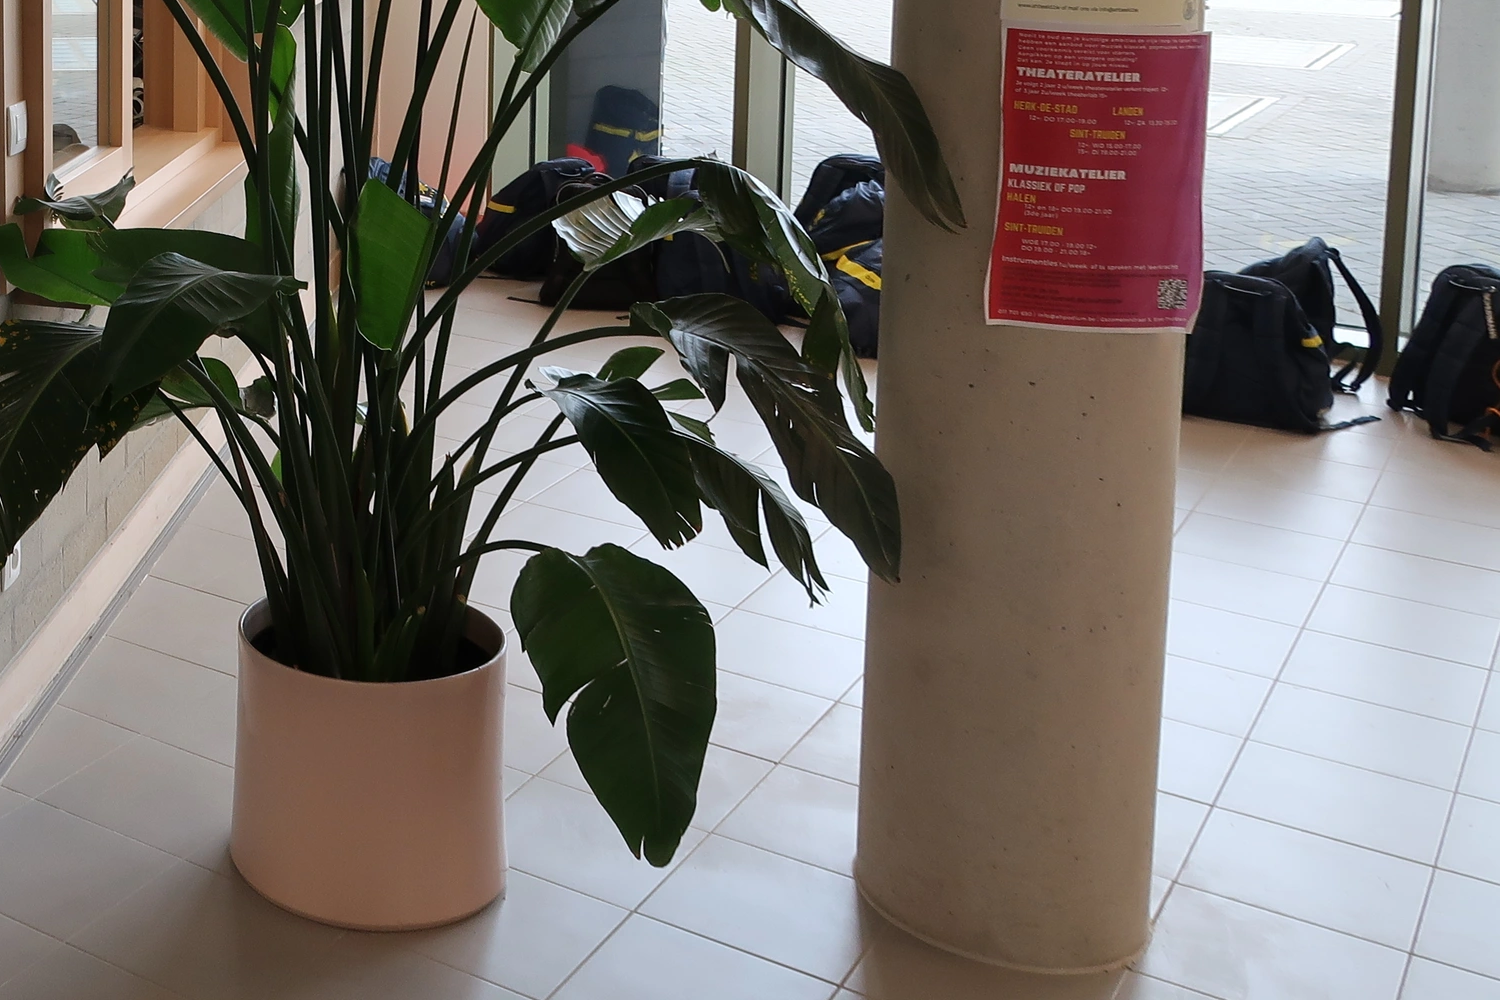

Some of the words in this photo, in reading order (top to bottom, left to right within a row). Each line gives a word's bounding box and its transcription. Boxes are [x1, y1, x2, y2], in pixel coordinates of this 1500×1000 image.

[1016, 66, 1140, 82] THEATERATELIER
[1014, 100, 1078, 114] HERK-DE-STAD
[1112, 106, 1144, 116] LANDEN
[1069, 129, 1126, 139] SINT-TRUIDEN
[1009, 163, 1127, 180] MUZIEKATELIER
[1007, 178, 1052, 191] KLASSIEK
[1054, 183, 1065, 193] OF
[1068, 184, 1086, 194] POP
[1007, 192, 1036, 203] HALEN
[1004, 222, 1063, 235] SINT-TRUIDEN
